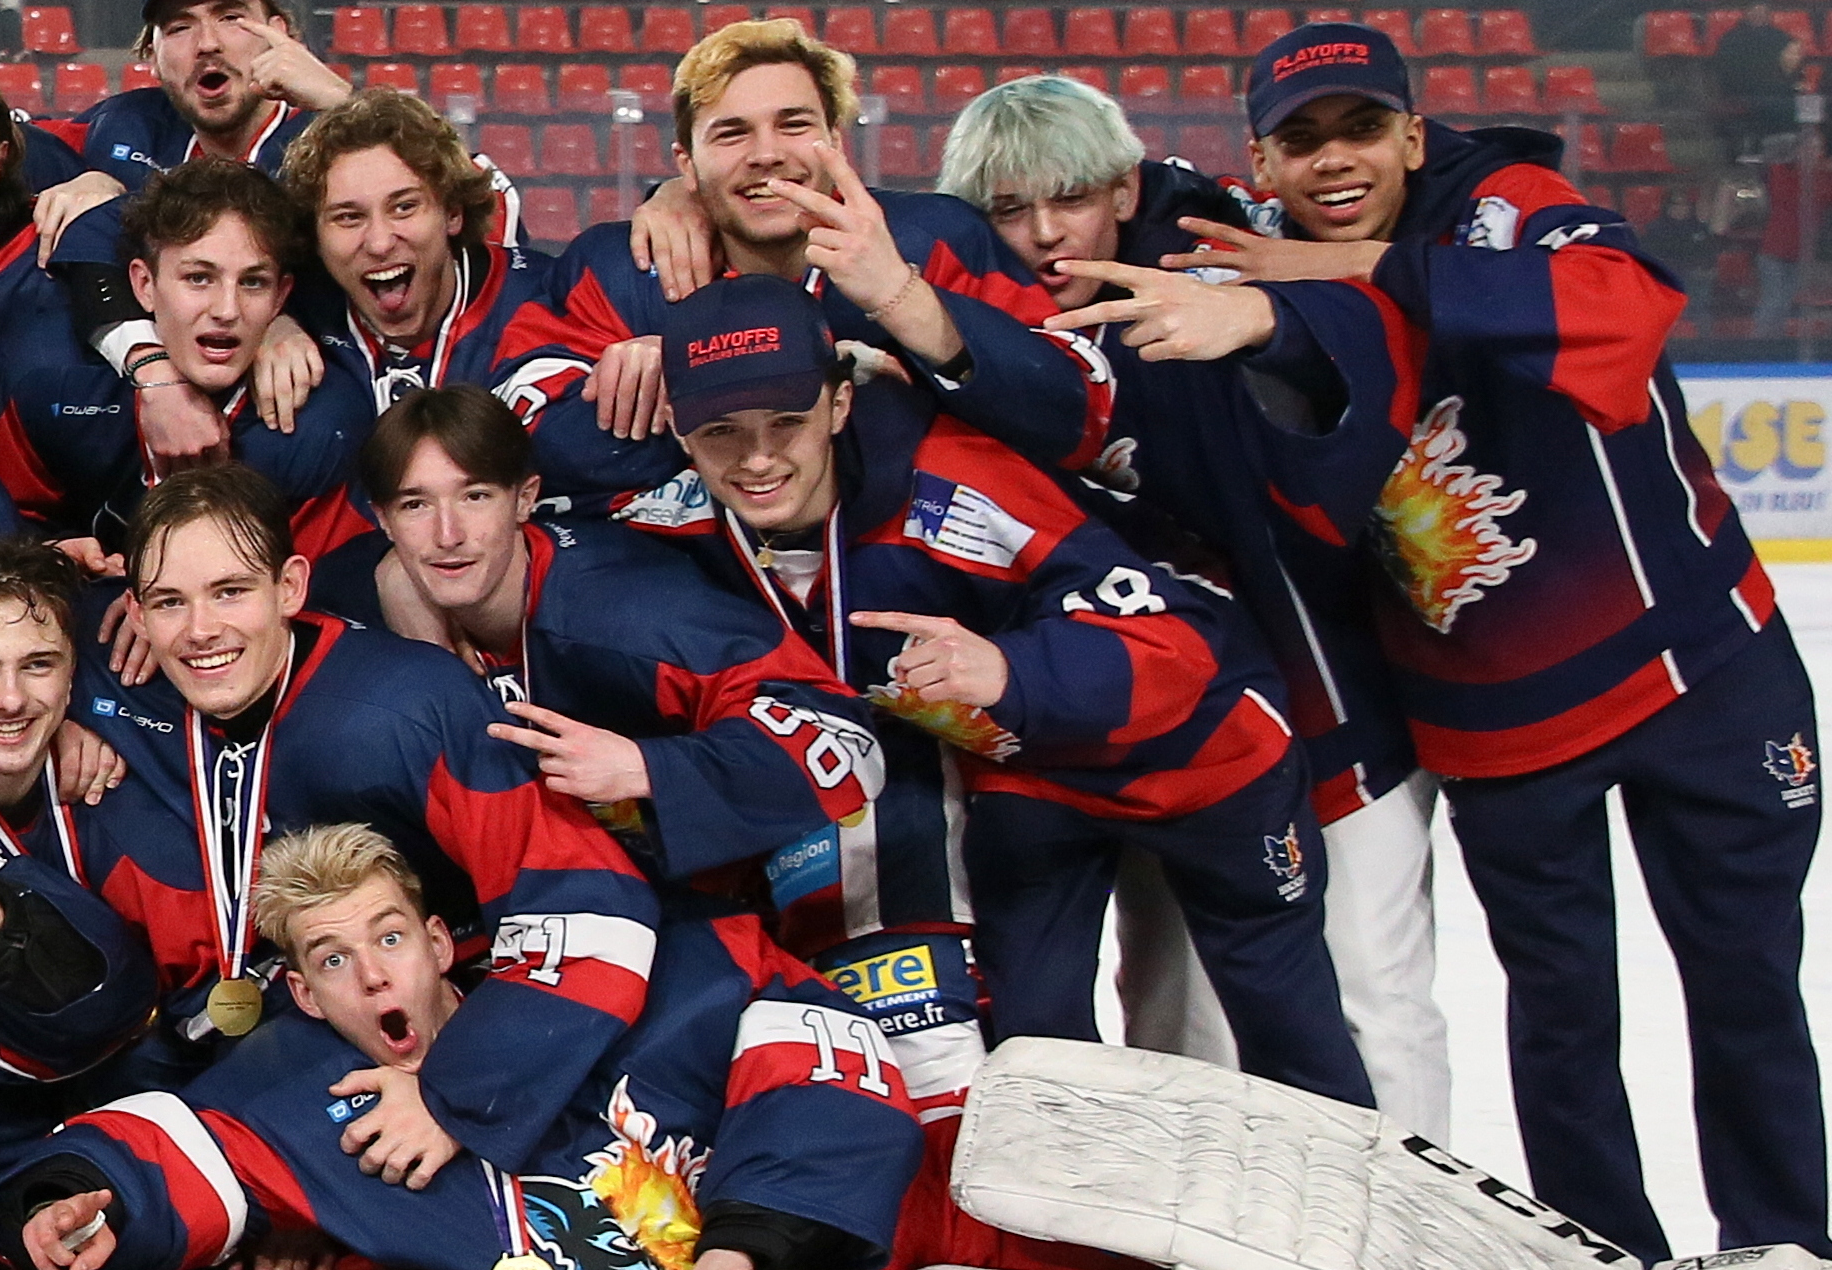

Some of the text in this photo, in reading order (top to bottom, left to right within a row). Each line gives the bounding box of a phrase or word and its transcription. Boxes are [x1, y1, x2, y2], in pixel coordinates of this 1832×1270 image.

[1273, 43, 1369, 74] PLAYOFFS
[689, 327, 778, 357] PLAYOFFS
[865, 991, 939, 1011] TEMENT
[882, 1003, 947, 1034] ere.fr
[803, 1010, 890, 1097] 11
[1404, 1134, 1625, 1266] CCM
